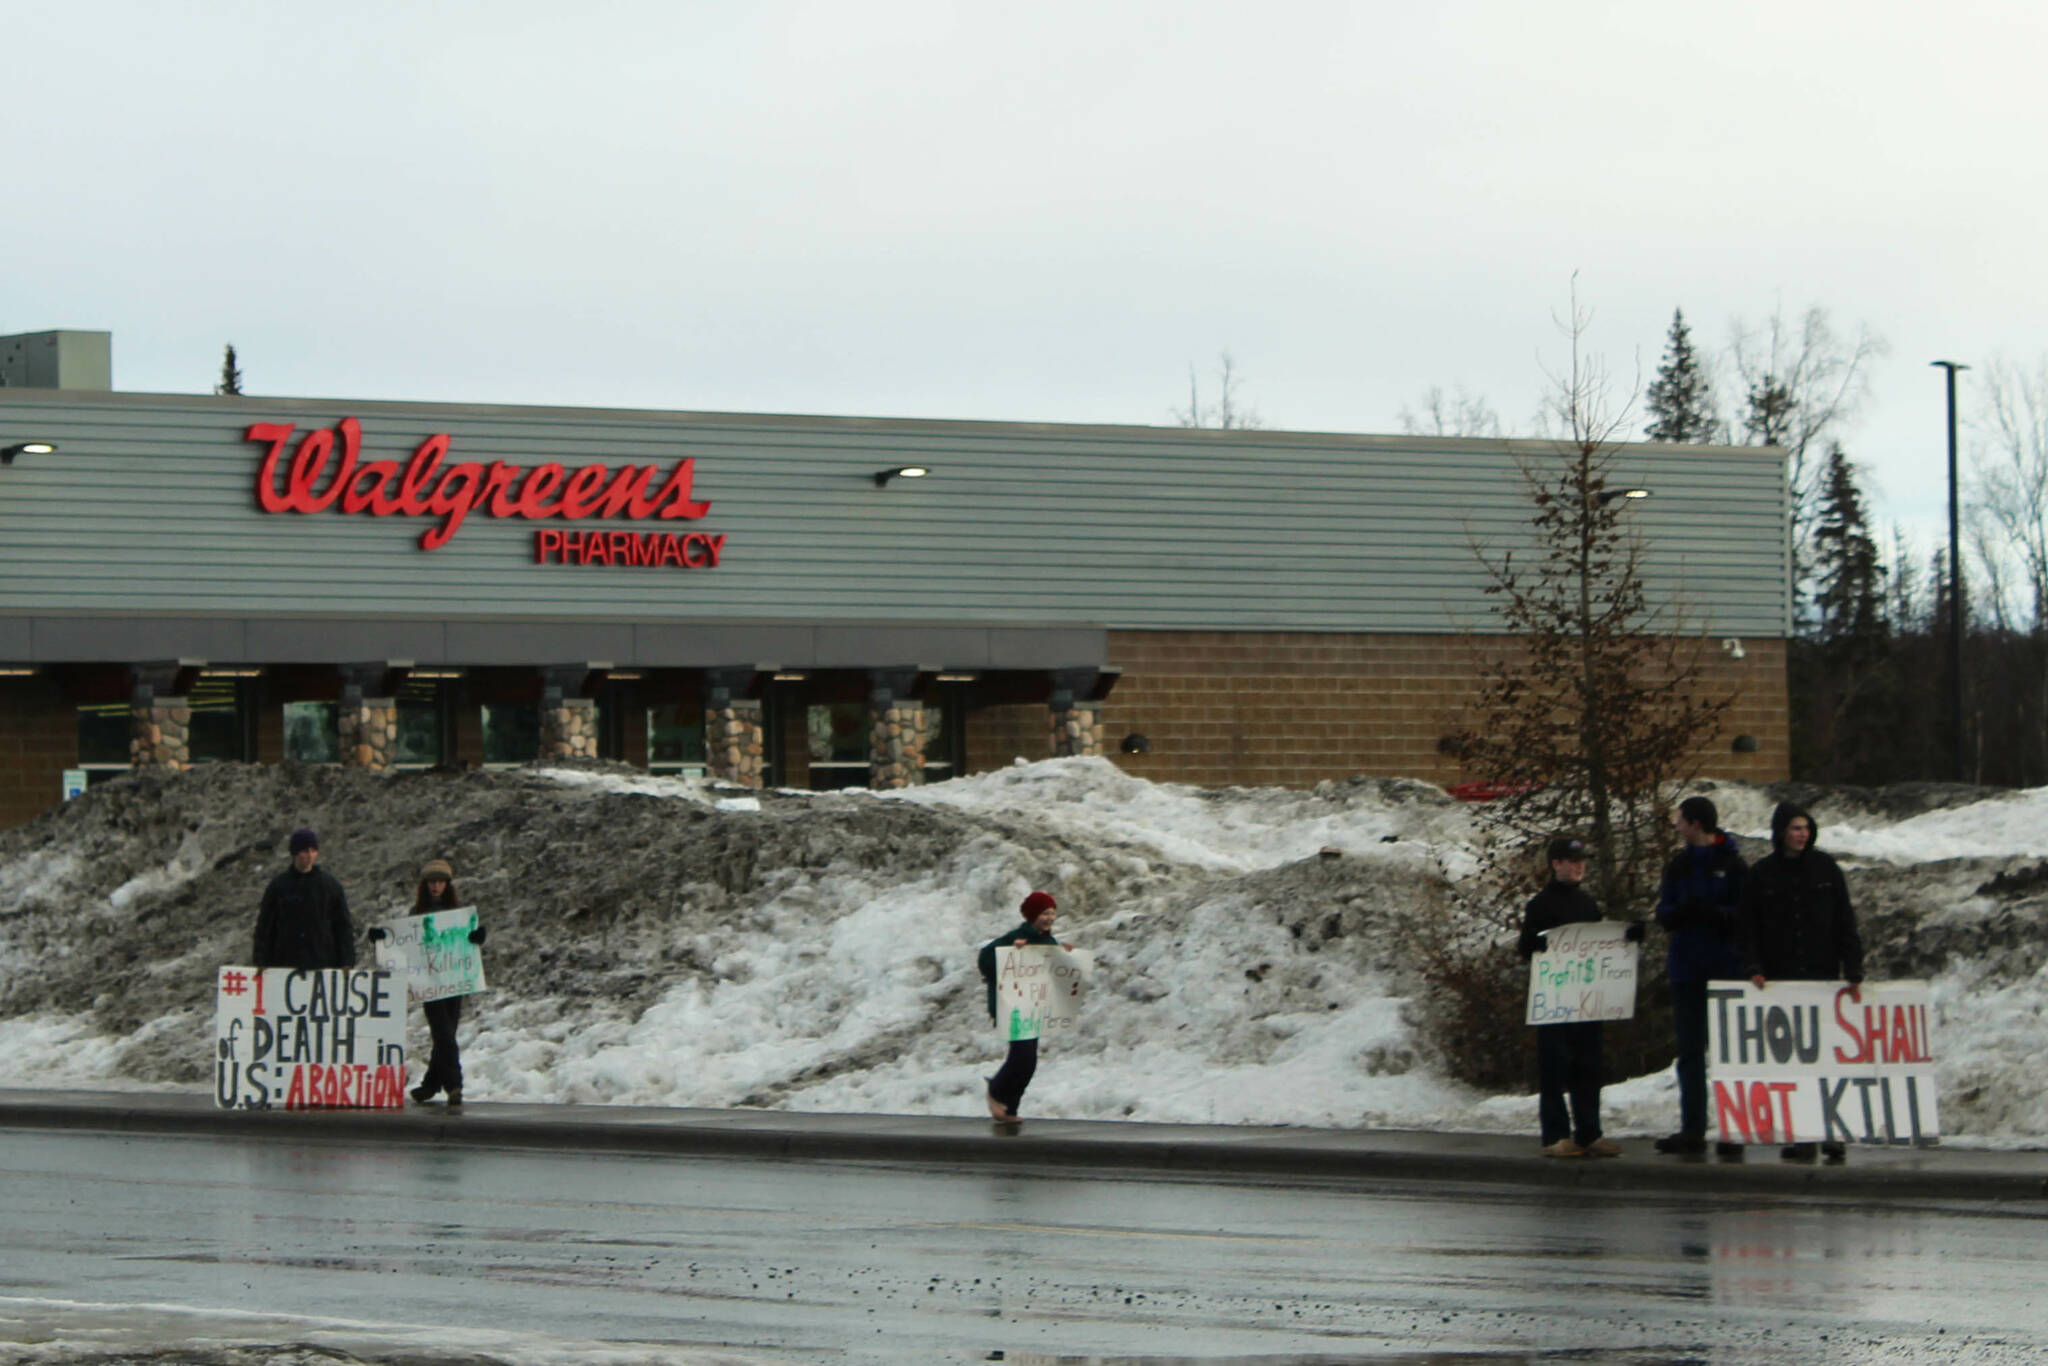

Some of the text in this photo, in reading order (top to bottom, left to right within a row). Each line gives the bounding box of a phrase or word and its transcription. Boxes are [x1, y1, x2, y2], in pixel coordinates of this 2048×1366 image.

[244, 416, 712, 551] Walgreens
[534, 529, 727, 567] PHARMACY
[1601, 956, 1632, 980] From
[222, 969, 392, 1018] #1 CAUSE
[218, 1016, 405, 1065] of DEATH in
[1707, 986, 1933, 1064] THOU SHALL
[1713, 1076, 1940, 1145] NOT KILL
